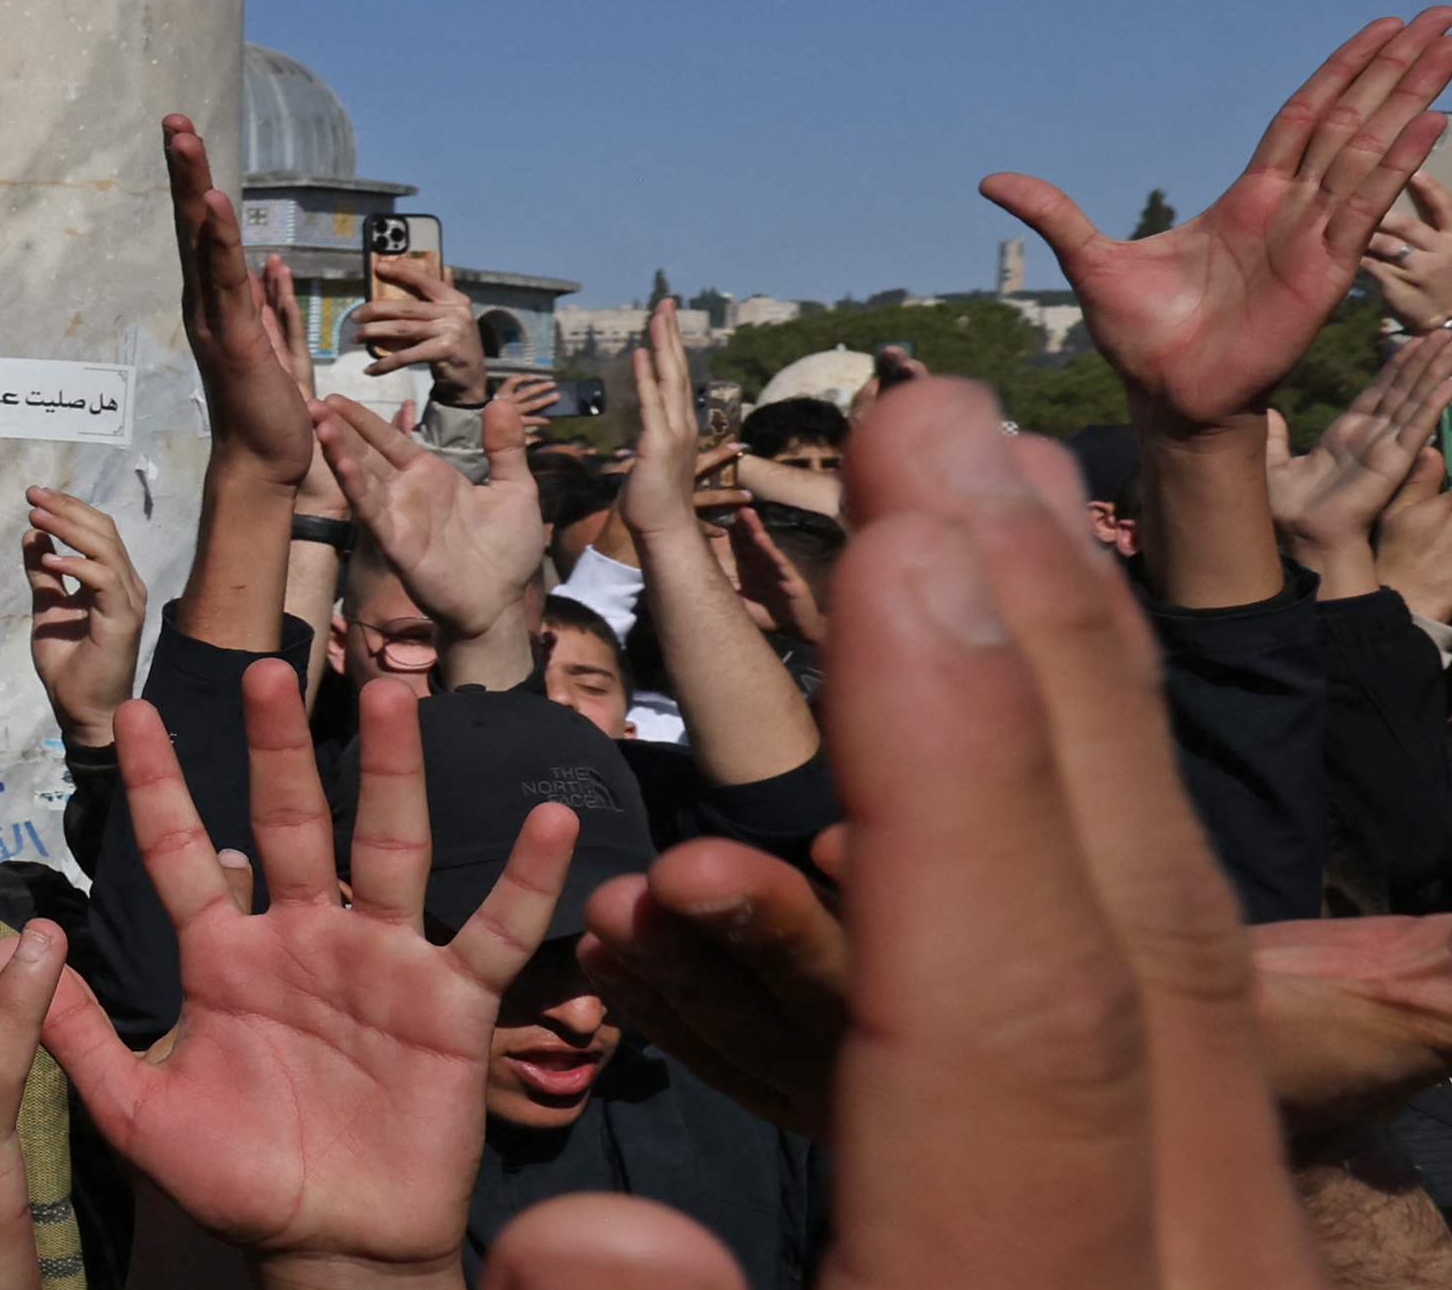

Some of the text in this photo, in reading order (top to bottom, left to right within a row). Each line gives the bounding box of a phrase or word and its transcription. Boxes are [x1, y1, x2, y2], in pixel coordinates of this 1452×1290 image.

[25, 390, 87, 415] صليت
[89, 393, 119, 415] هل
[549, 767, 589, 780] THE
